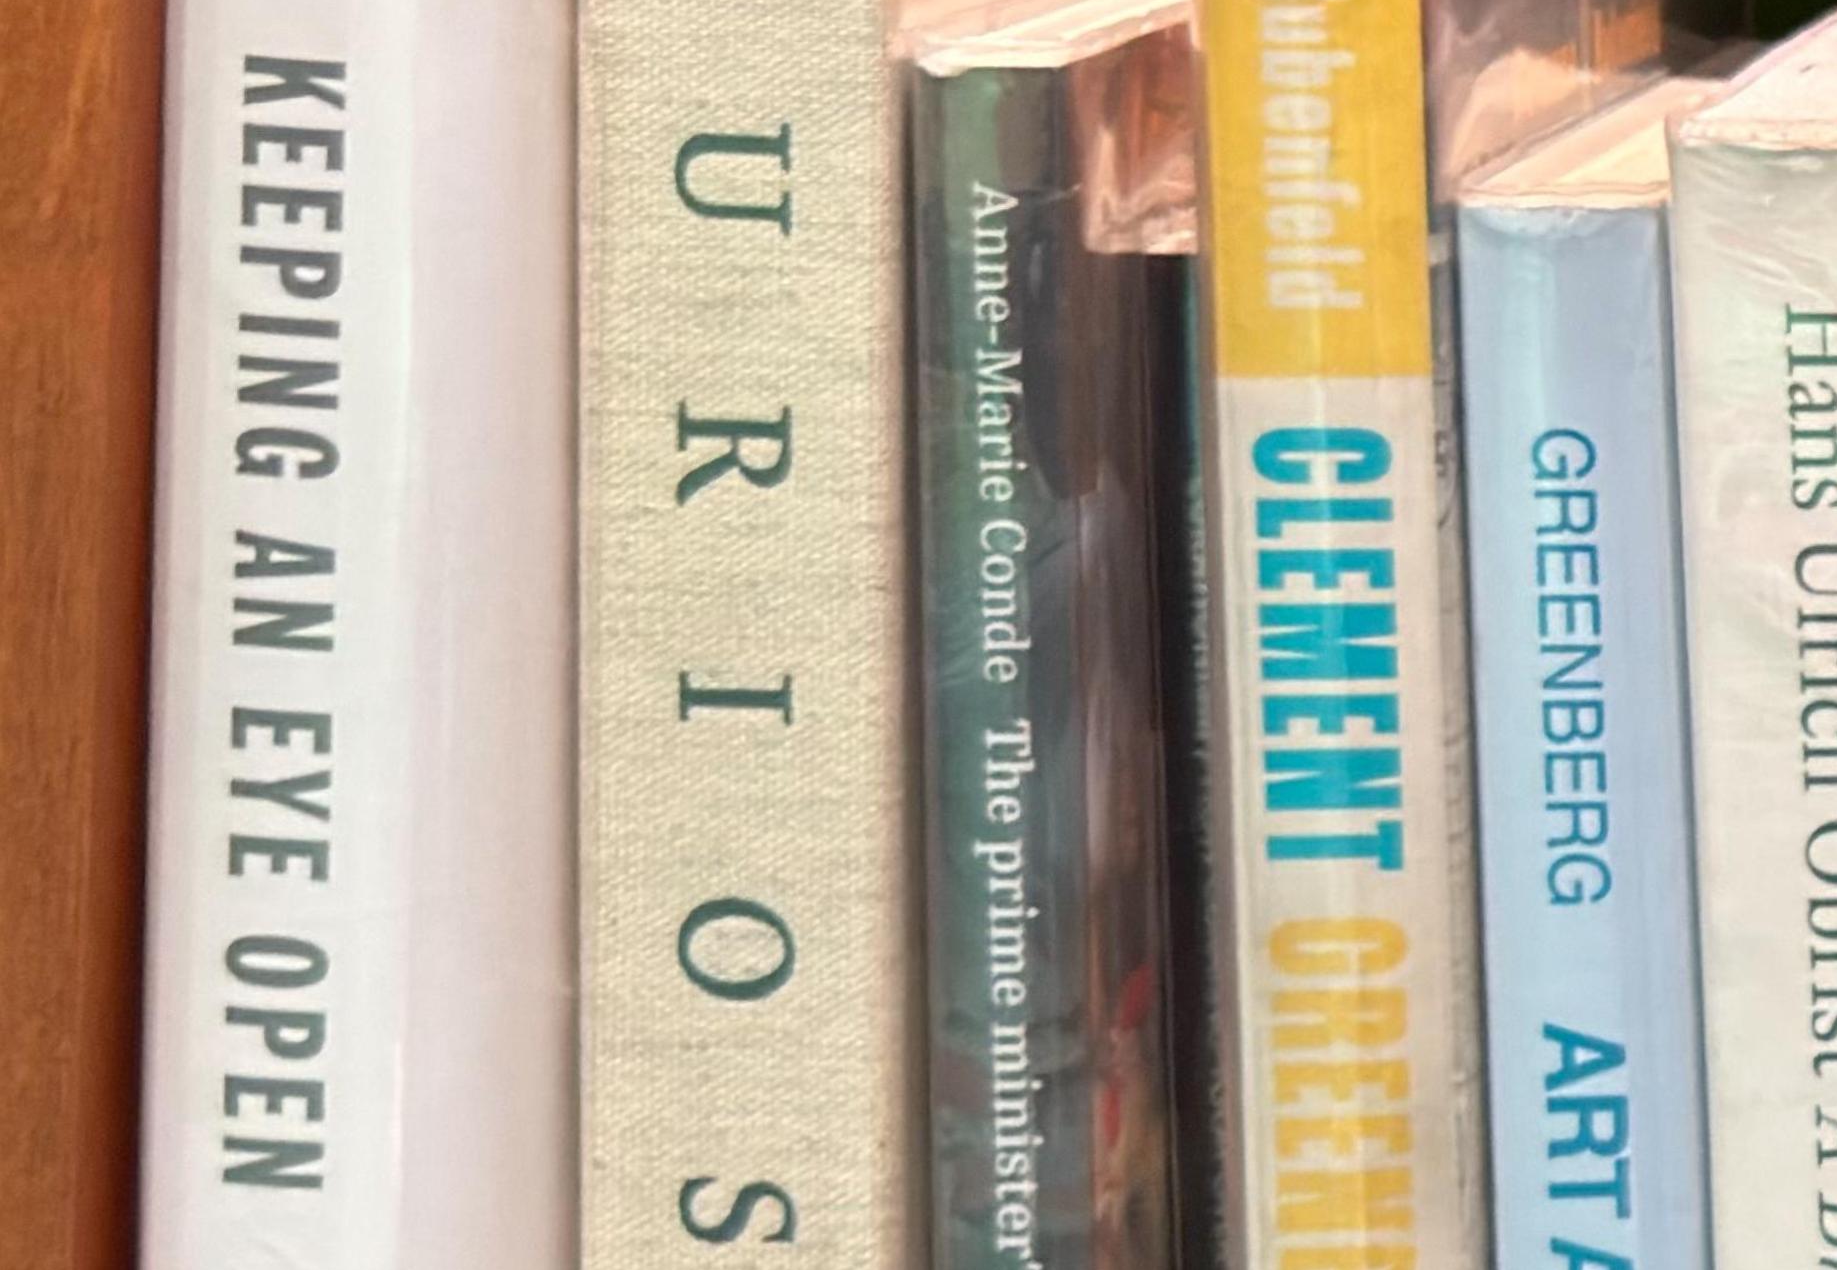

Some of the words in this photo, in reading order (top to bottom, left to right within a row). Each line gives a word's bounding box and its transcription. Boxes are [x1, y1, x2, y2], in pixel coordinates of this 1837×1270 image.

[236, 54, 347, 480] KEEPING
[972, 182, 1026, 502] Anne-Marie
[232, 530, 336, 652] AN
[978, 518, 1031, 682] Conde
[1253, 428, 1405, 870] CLEMENT
[1534, 428, 1611, 904] GREENBERG
[228, 706, 332, 882] EYE
[977, 836, 1035, 1006] prime
[223, 935, 330, 1190] OPEN
[1543, 1023, 1632, 1219] ART
